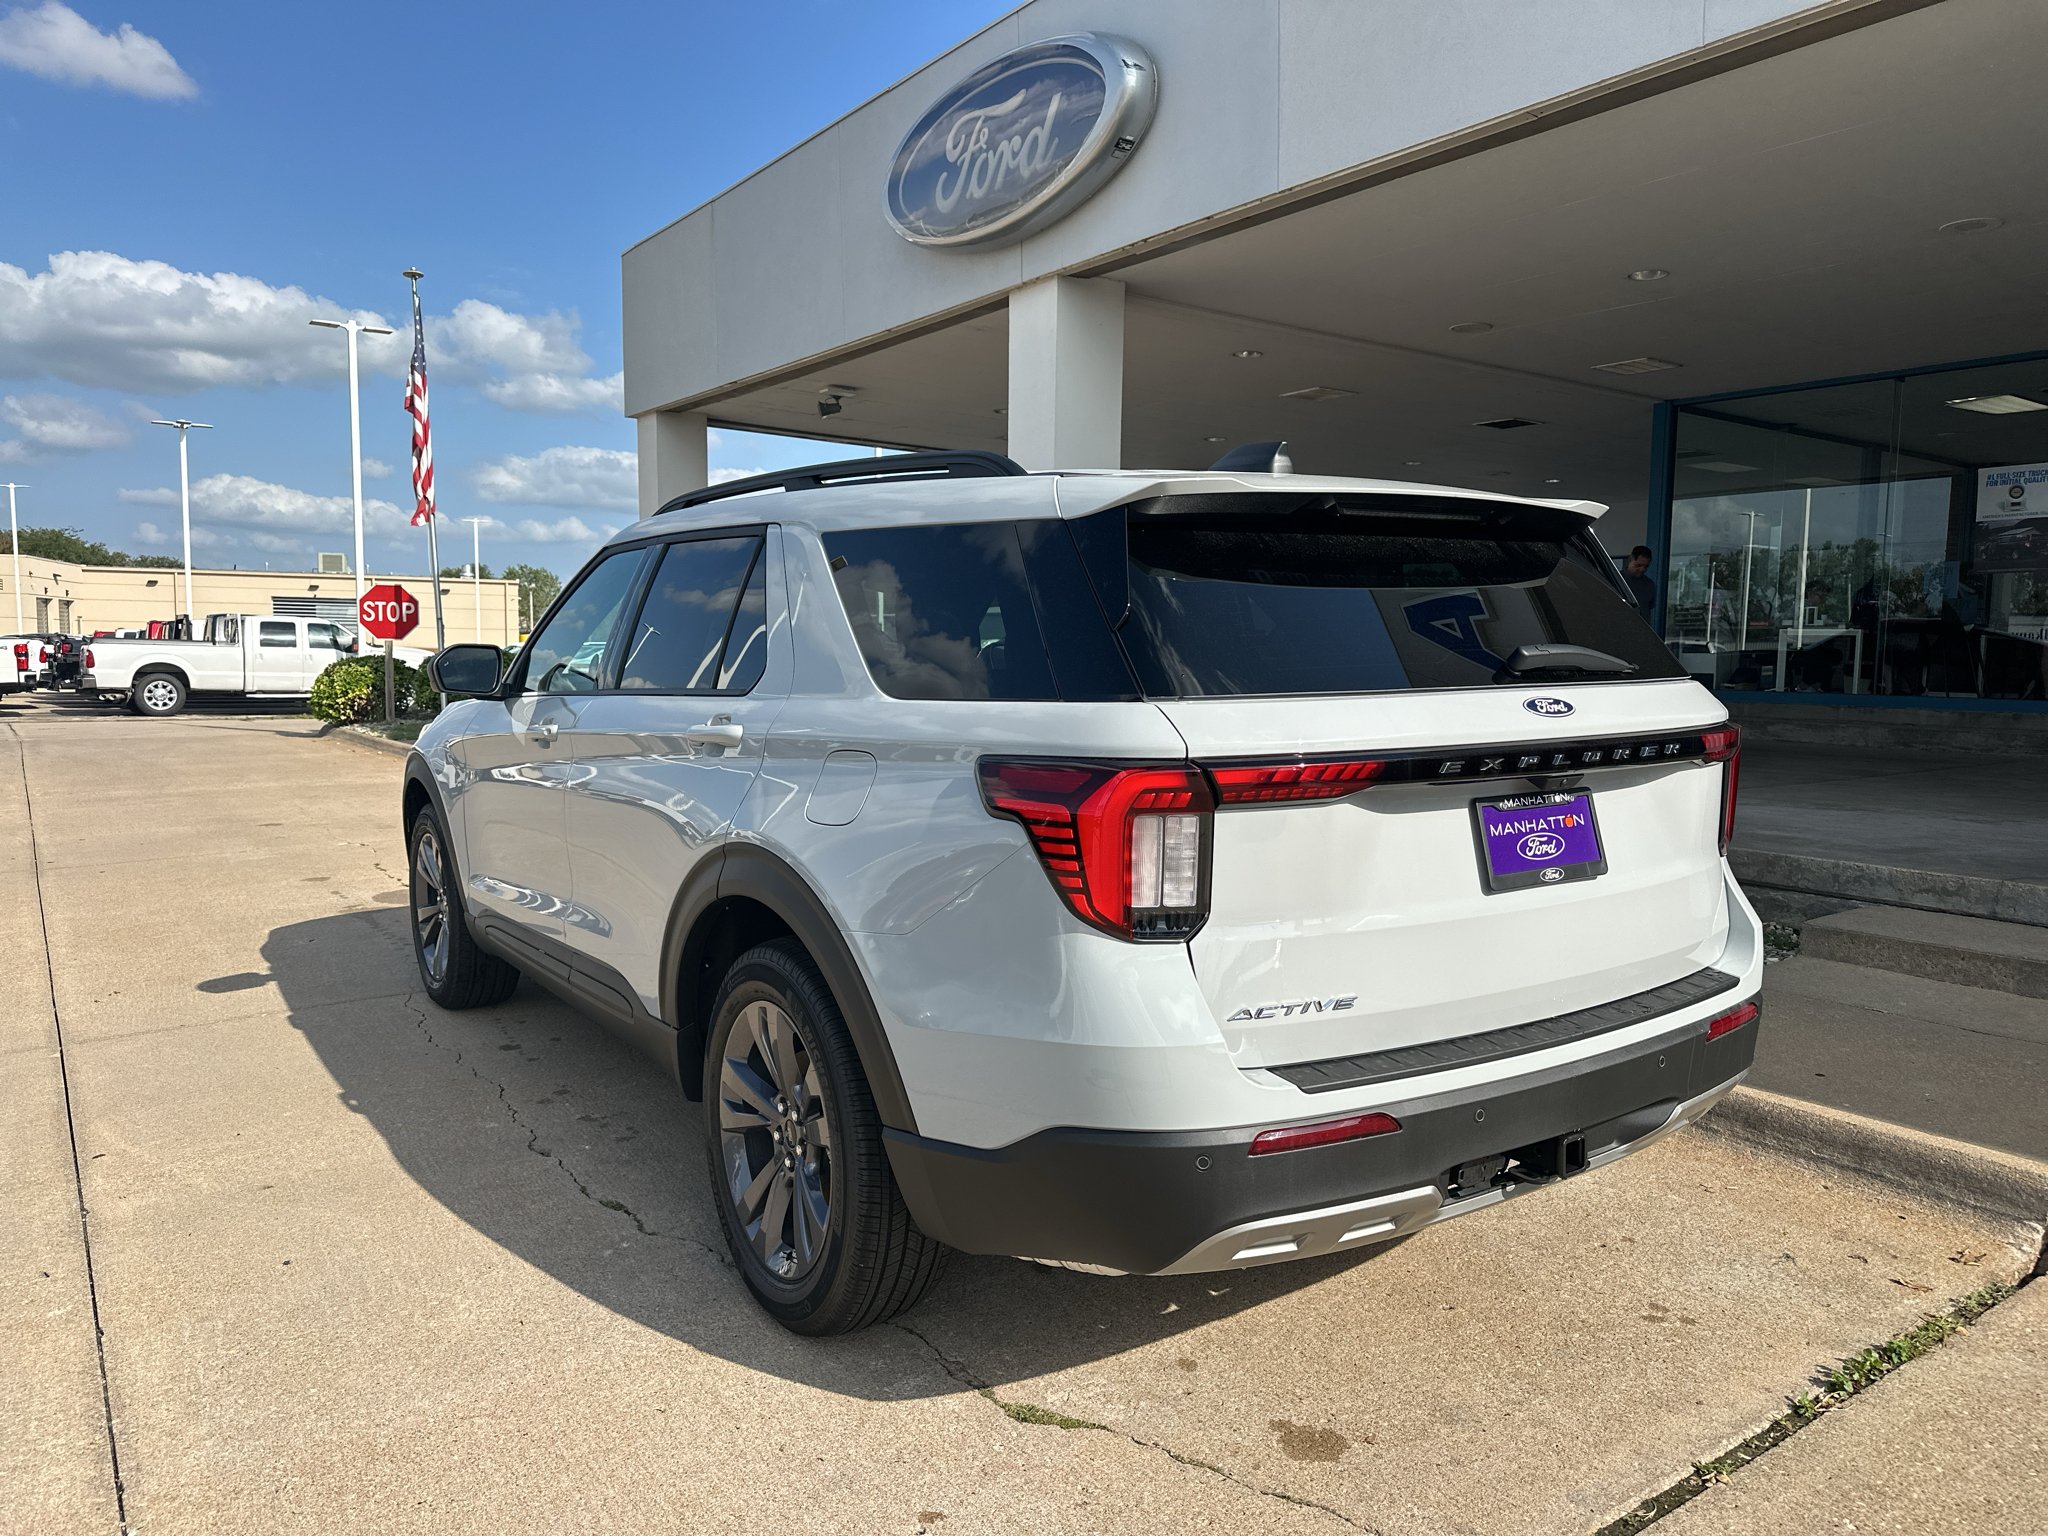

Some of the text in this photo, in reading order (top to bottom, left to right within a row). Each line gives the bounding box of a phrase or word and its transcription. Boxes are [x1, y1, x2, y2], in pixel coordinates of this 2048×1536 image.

[935, 89, 1062, 214] Ford
[1996, 471, 2026, 479] FULL-SIZE
[362, 600, 416, 623] STOP
[1534, 696, 1569, 715] Ford
[1439, 743, 1682, 774] EXPLORER
[1525, 836, 1557, 857] Ford
[1226, 995, 1359, 1022] ACTIVE
